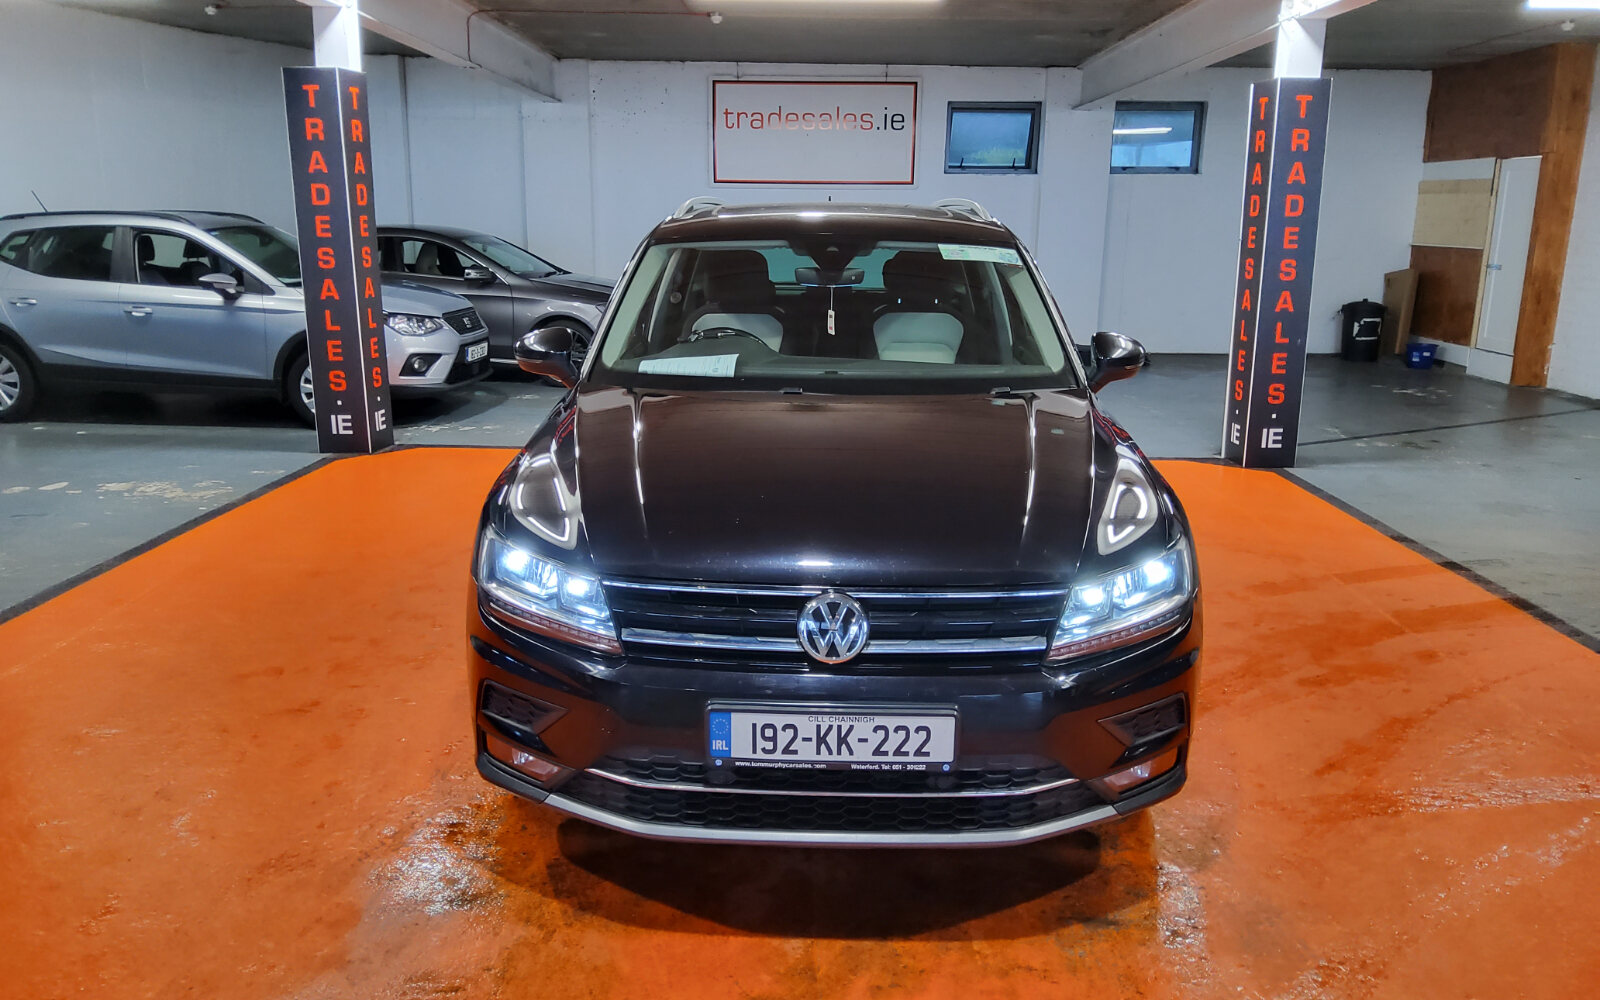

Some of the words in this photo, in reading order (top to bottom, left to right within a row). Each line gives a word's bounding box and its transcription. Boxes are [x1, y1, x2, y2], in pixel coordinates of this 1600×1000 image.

[723, 106, 905, 131] tradesales.ie
[808, 715, 826, 723] CILL
[712, 739, 729, 751] IRL
[751, 722, 932, 757] 192-KK-222
